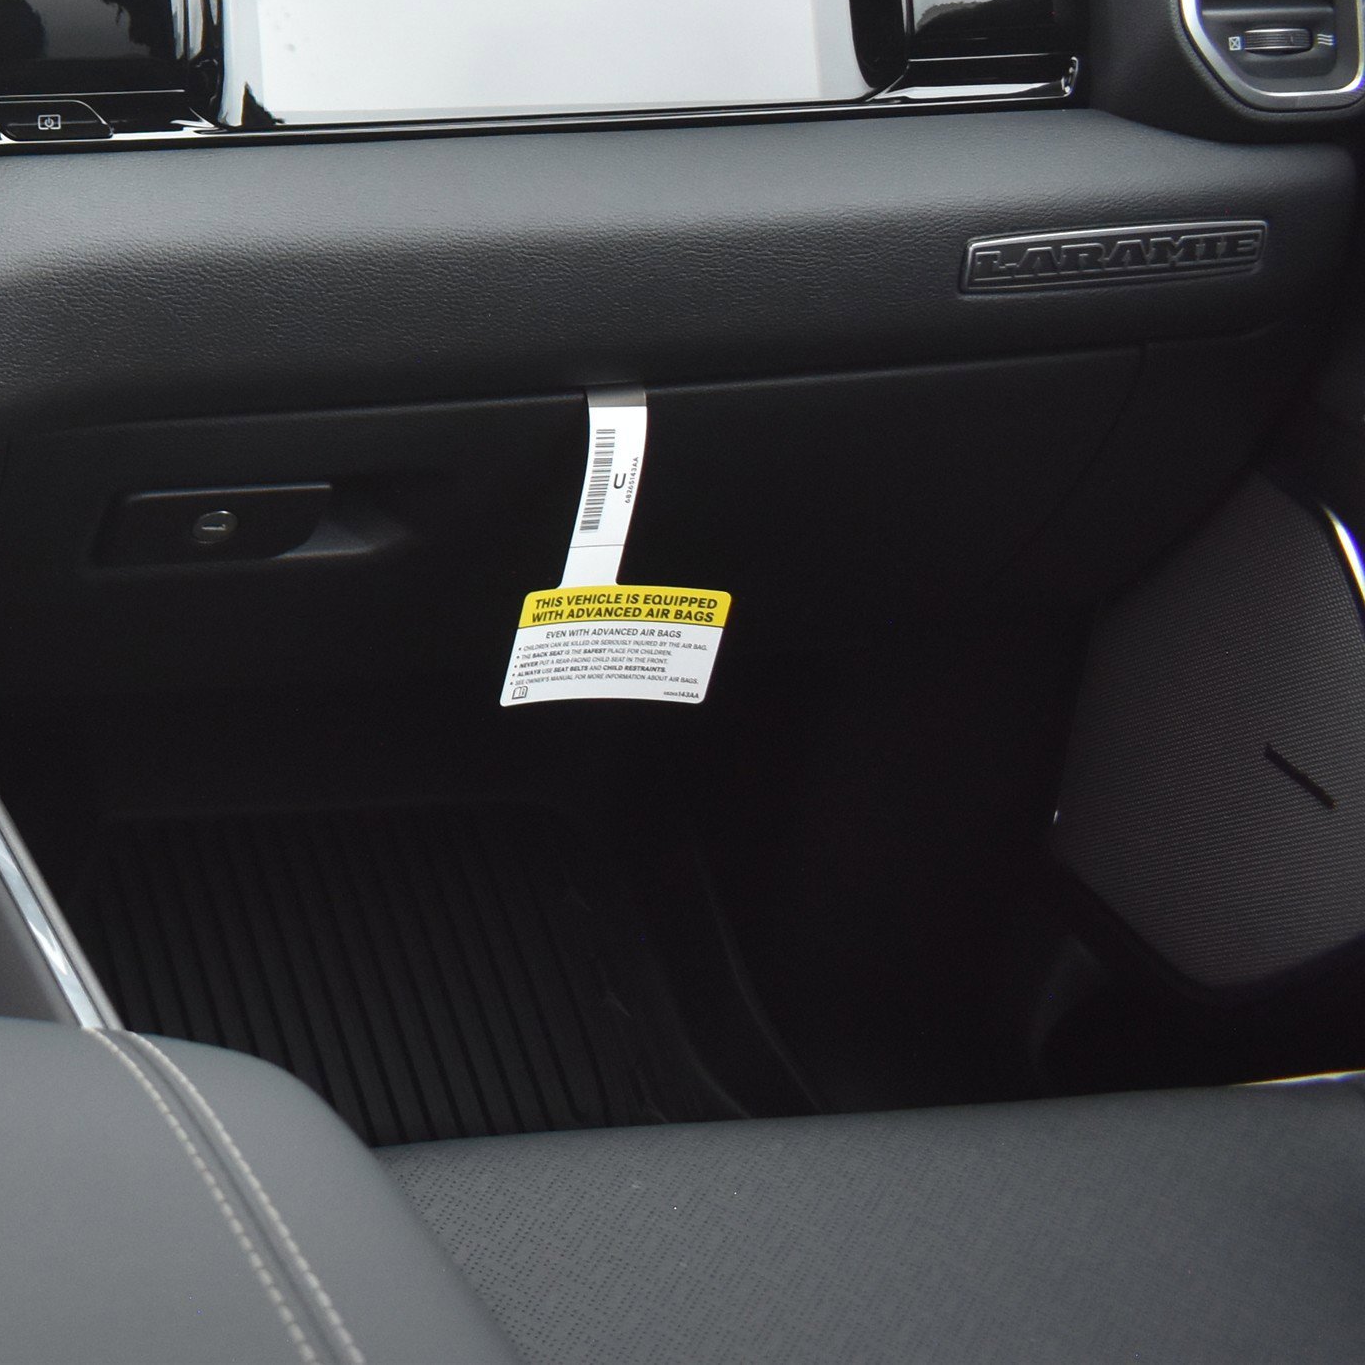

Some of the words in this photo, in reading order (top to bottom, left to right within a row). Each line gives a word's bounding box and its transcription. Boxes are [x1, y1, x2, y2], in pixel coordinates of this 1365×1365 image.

[535, 596, 563, 610] THIS
[566, 593, 624, 606] VEHICLE
[625, 593, 640, 604] IS
[643, 594, 718, 610] EQUIPPED
[532, 609, 564, 623] WITH
[566, 606, 643, 620] ADVANCED
[645, 607, 671, 619] AIR
[673, 609, 715, 623] BAGS
[545, 630, 567, 639] EVEN
[568, 629, 590, 637] WITH
[591, 628, 639, 637] ADVANCED
[640, 628, 656, 637] AIR
[657, 629, 682, 639] BAGS
